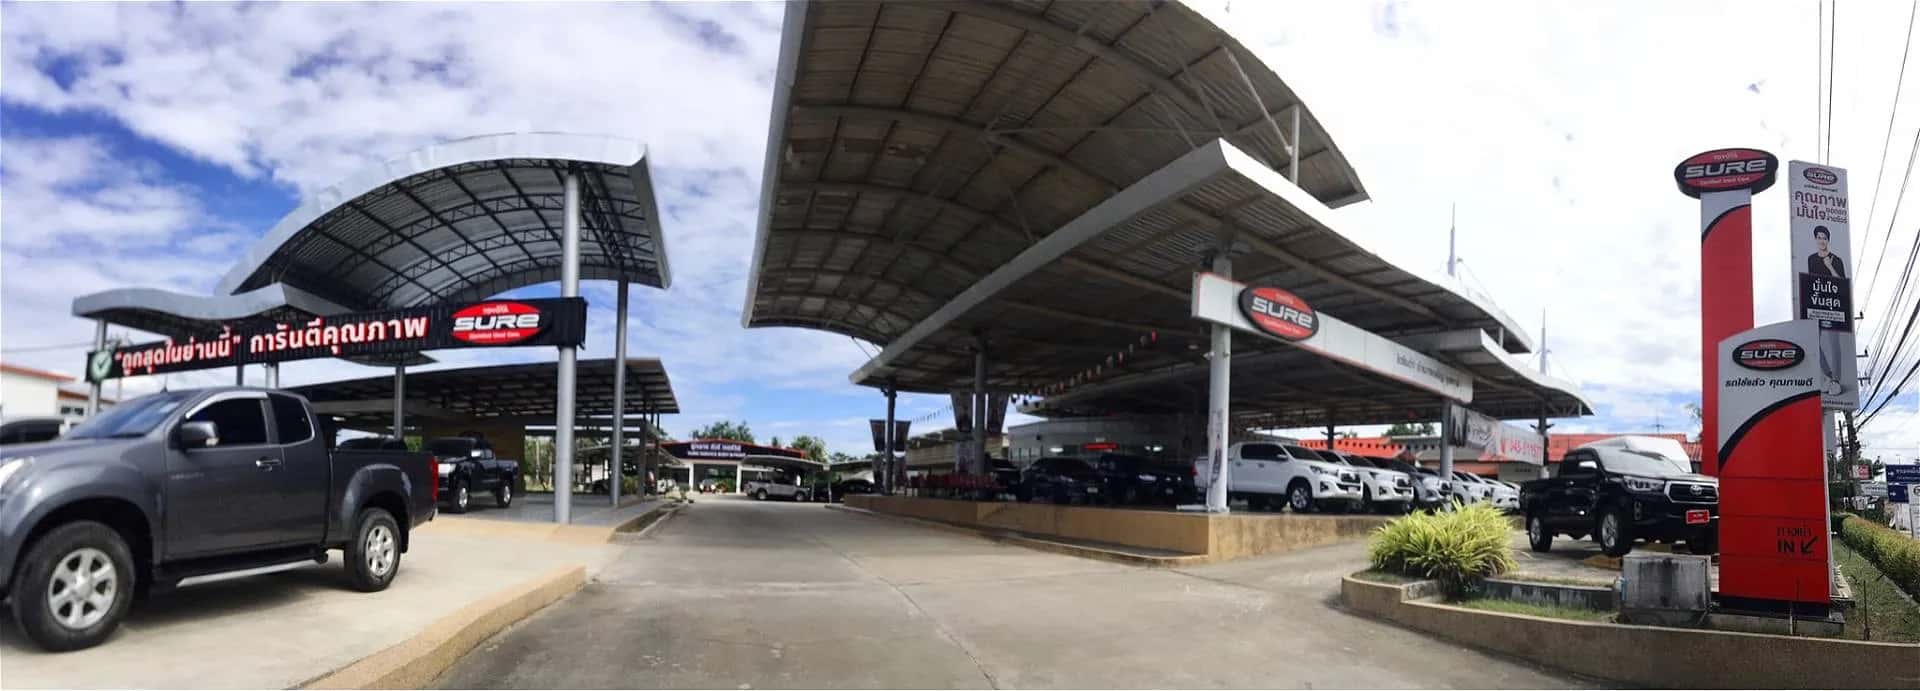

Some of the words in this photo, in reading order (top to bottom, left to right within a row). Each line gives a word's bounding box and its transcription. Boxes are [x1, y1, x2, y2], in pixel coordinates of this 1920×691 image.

[1684, 159, 1767, 178] SURE
[1794, 190, 1847, 209] คุณภาพ
[1812, 277, 1838, 294] มั่นใจ
[1252, 296, 1312, 329] SURE
[453, 313, 540, 331] SURE
[250, 316, 427, 355] การันตีคุณภาพ
[1740, 349, 1797, 359] SURE
[1777, 539, 1795, 553] IN
